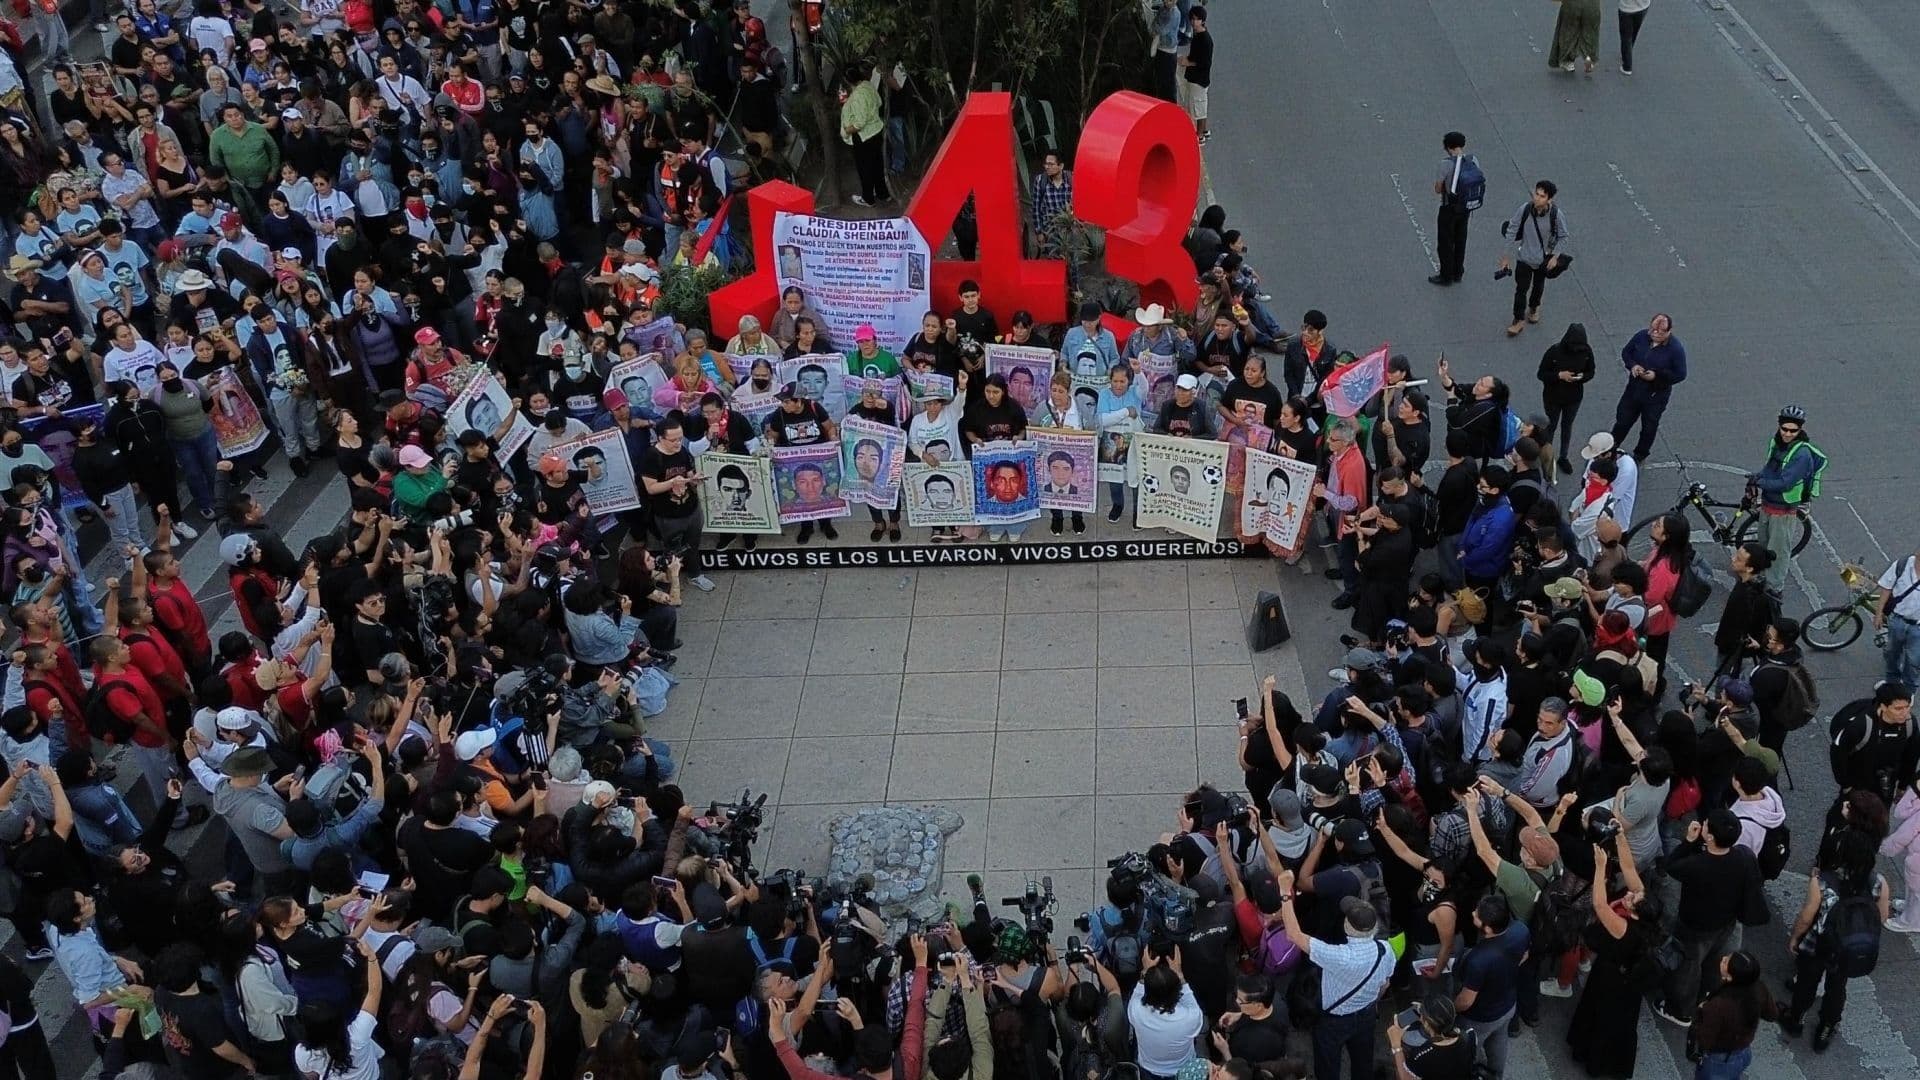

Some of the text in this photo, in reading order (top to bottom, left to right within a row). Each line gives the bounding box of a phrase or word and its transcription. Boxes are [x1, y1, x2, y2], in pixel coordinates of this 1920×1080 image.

[808, 217, 894, 231] PRESIDENTA
[792, 226, 909, 241] CLAUDIA SHEINBAUM
[701, 541, 1245, 567] UE VIVOS SE LOS LLEVARON, VIVOS LOS QUEREMOS!
